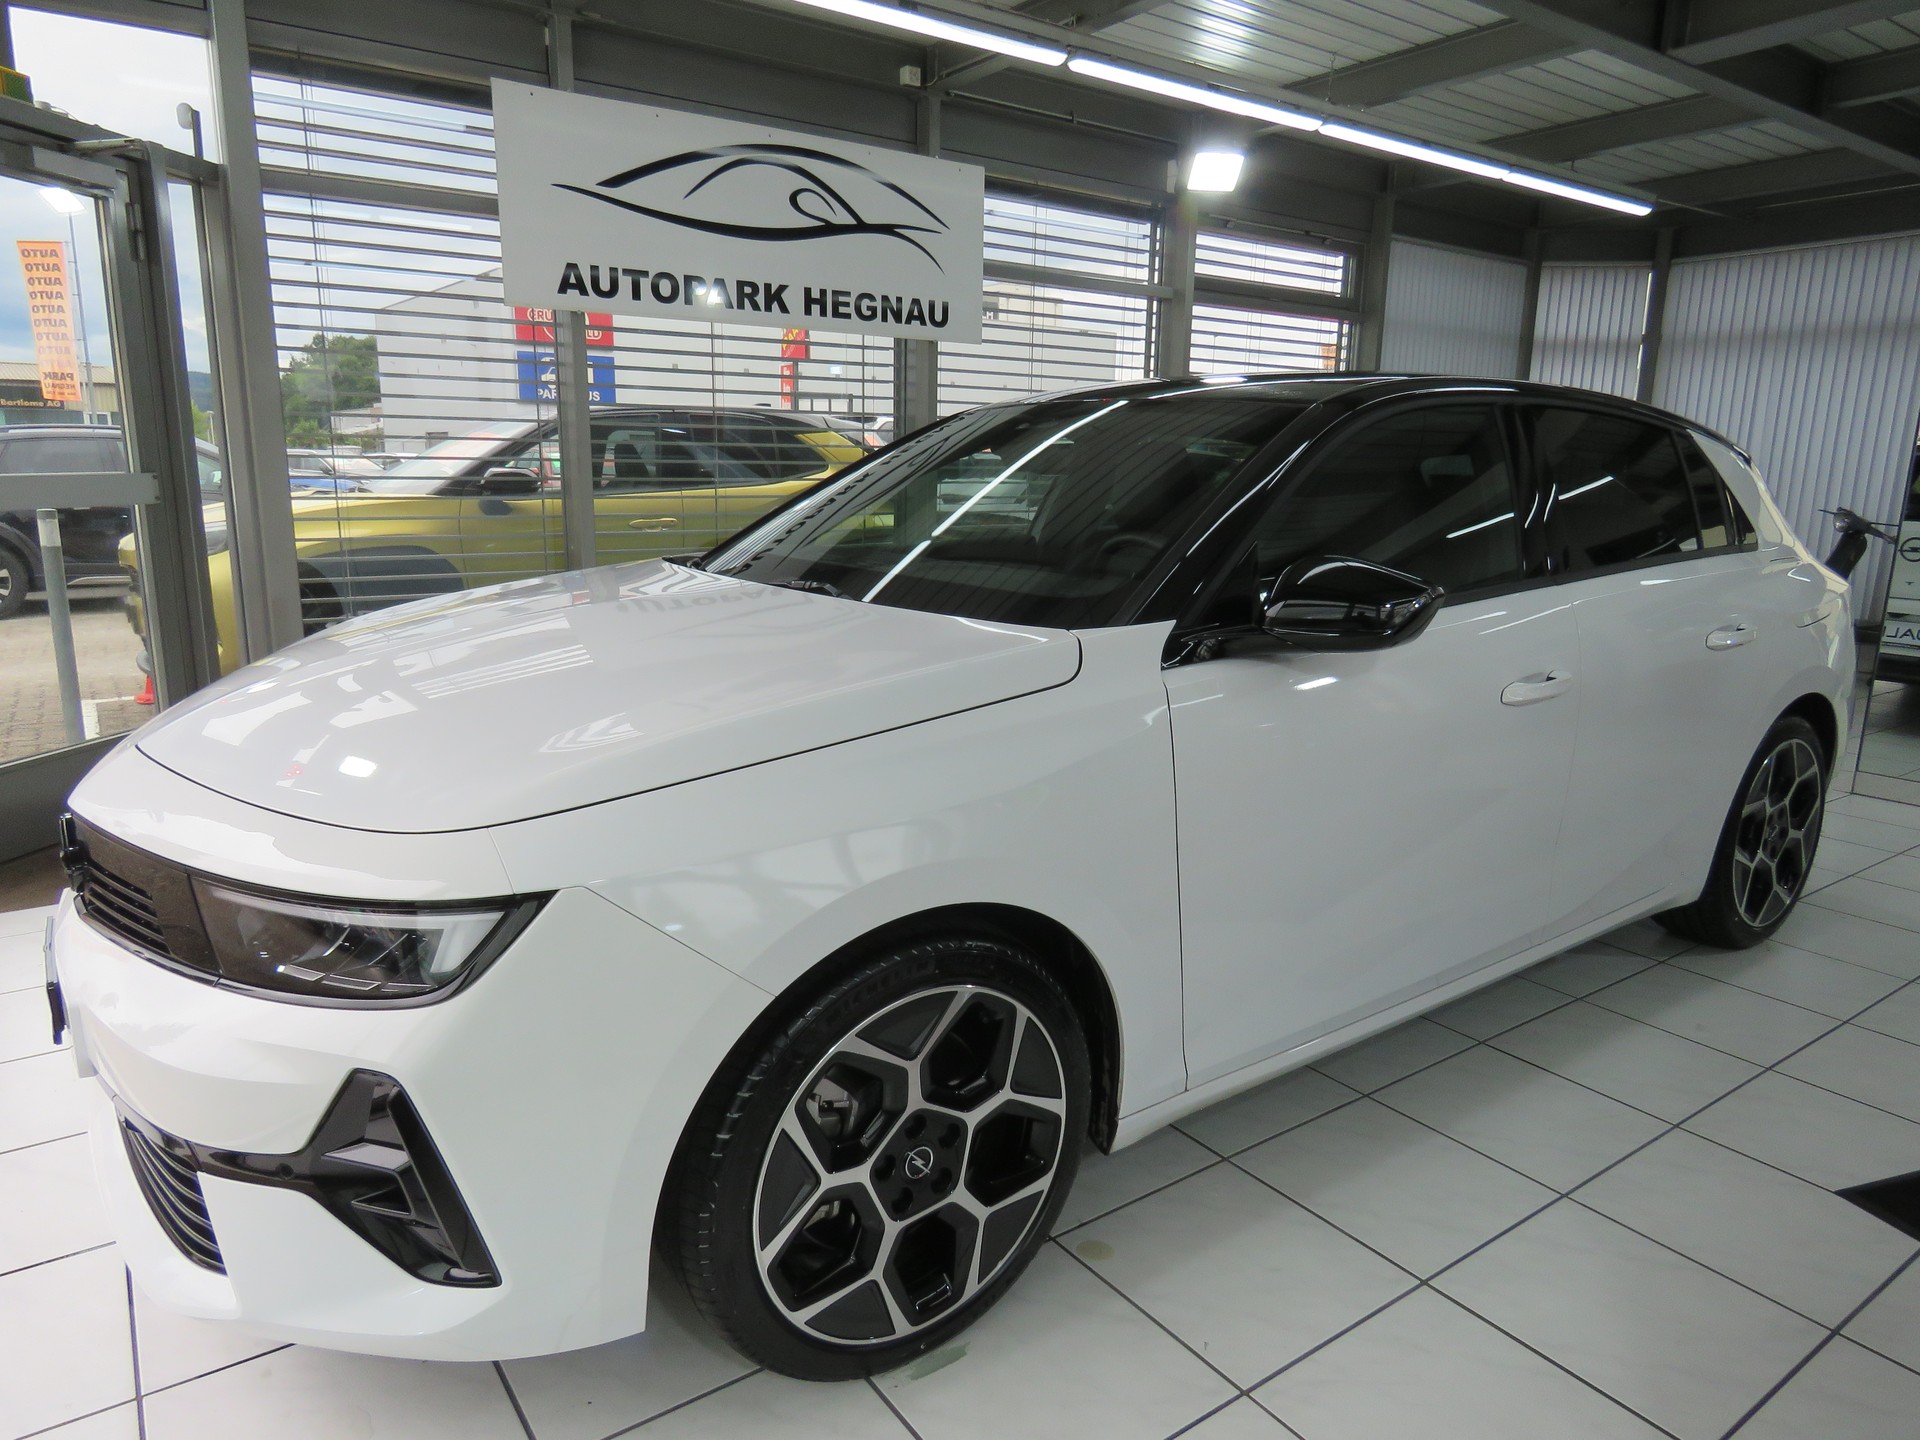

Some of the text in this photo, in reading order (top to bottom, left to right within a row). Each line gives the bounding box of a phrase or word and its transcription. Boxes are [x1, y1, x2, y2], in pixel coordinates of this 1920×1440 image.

[557, 262, 949, 329] AUTOPARK HEGNAU
[46, 400, 61, 408] AG
